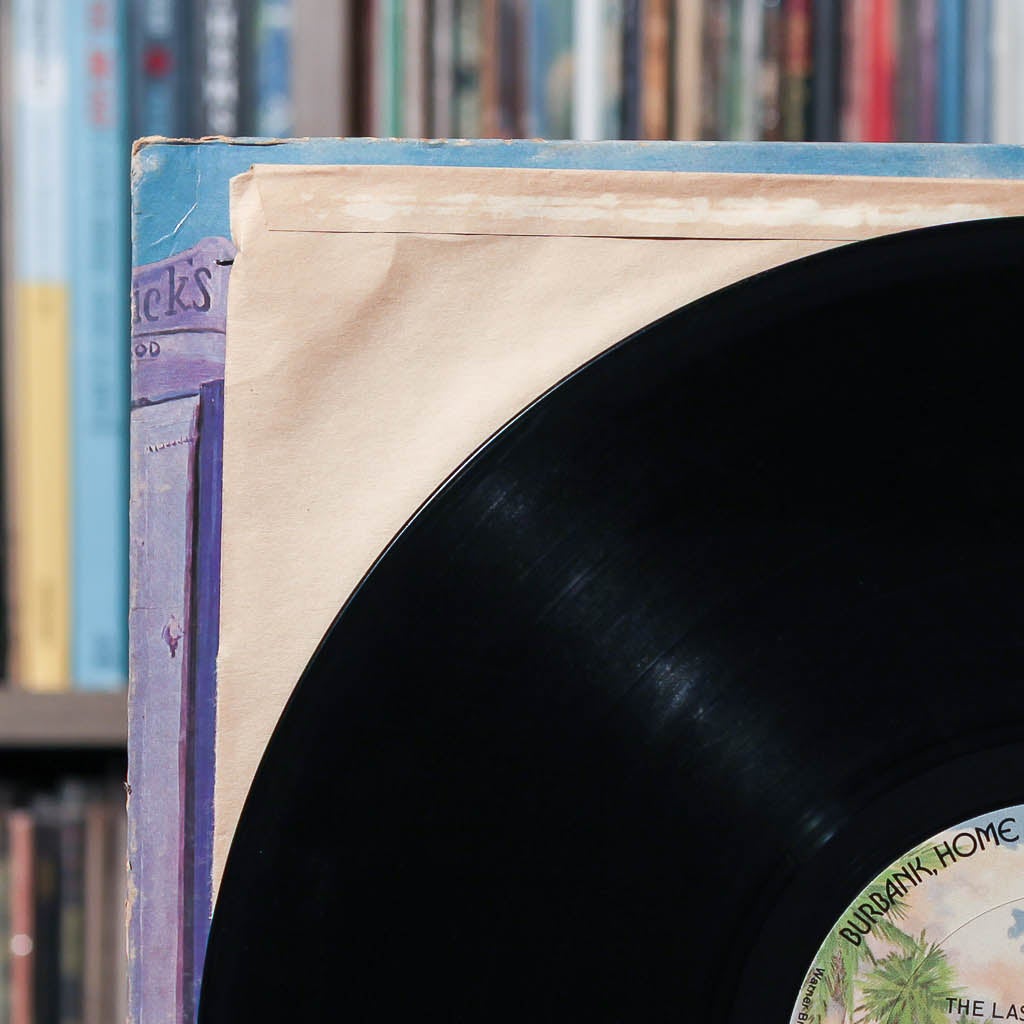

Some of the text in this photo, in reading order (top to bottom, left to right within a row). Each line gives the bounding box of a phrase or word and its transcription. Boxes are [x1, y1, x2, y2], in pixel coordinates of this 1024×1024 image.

[839, 856, 938, 947] BURBANK,
[933, 817, 1019, 868] HOME
[804, 968, 825, 1012] Warner
[946, 997, 985, 1017] THE
